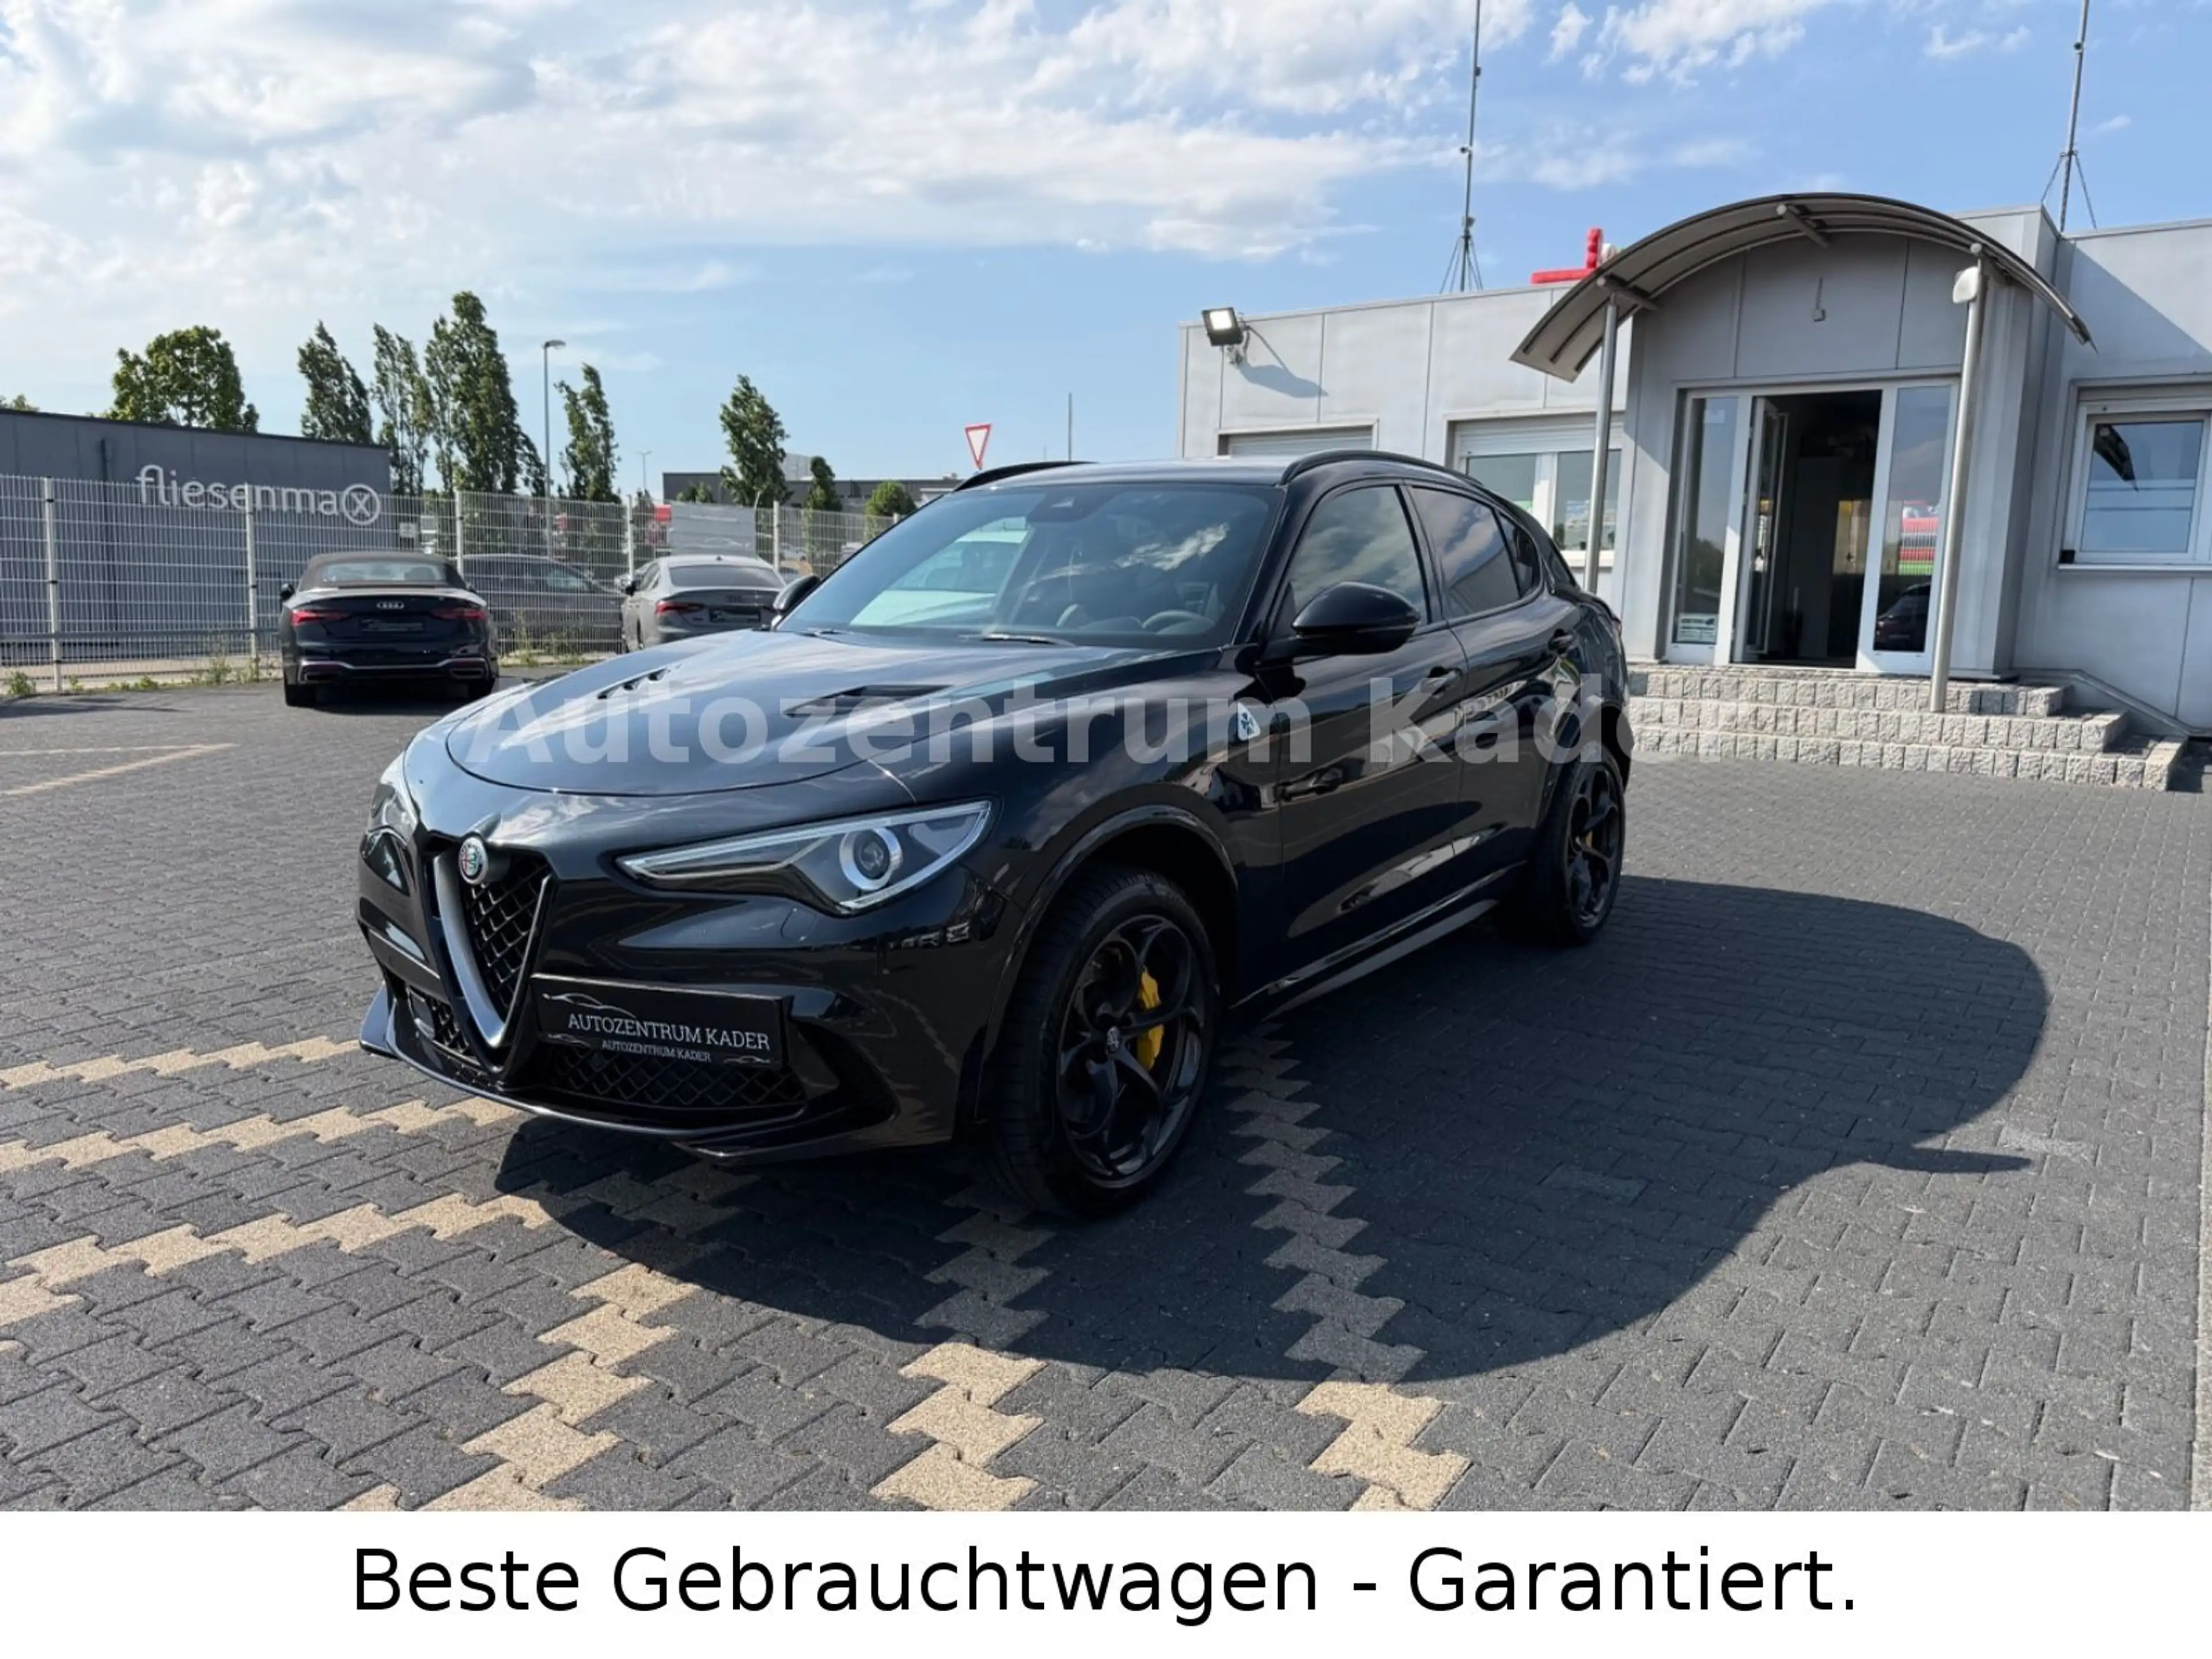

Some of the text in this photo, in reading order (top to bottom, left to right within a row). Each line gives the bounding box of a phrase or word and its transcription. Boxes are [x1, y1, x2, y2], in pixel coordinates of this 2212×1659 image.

[568, 1013, 770, 1051] AUTOZENTRUM KADER
[601, 1040, 712, 1063] AUTOZENTRUM KADER
